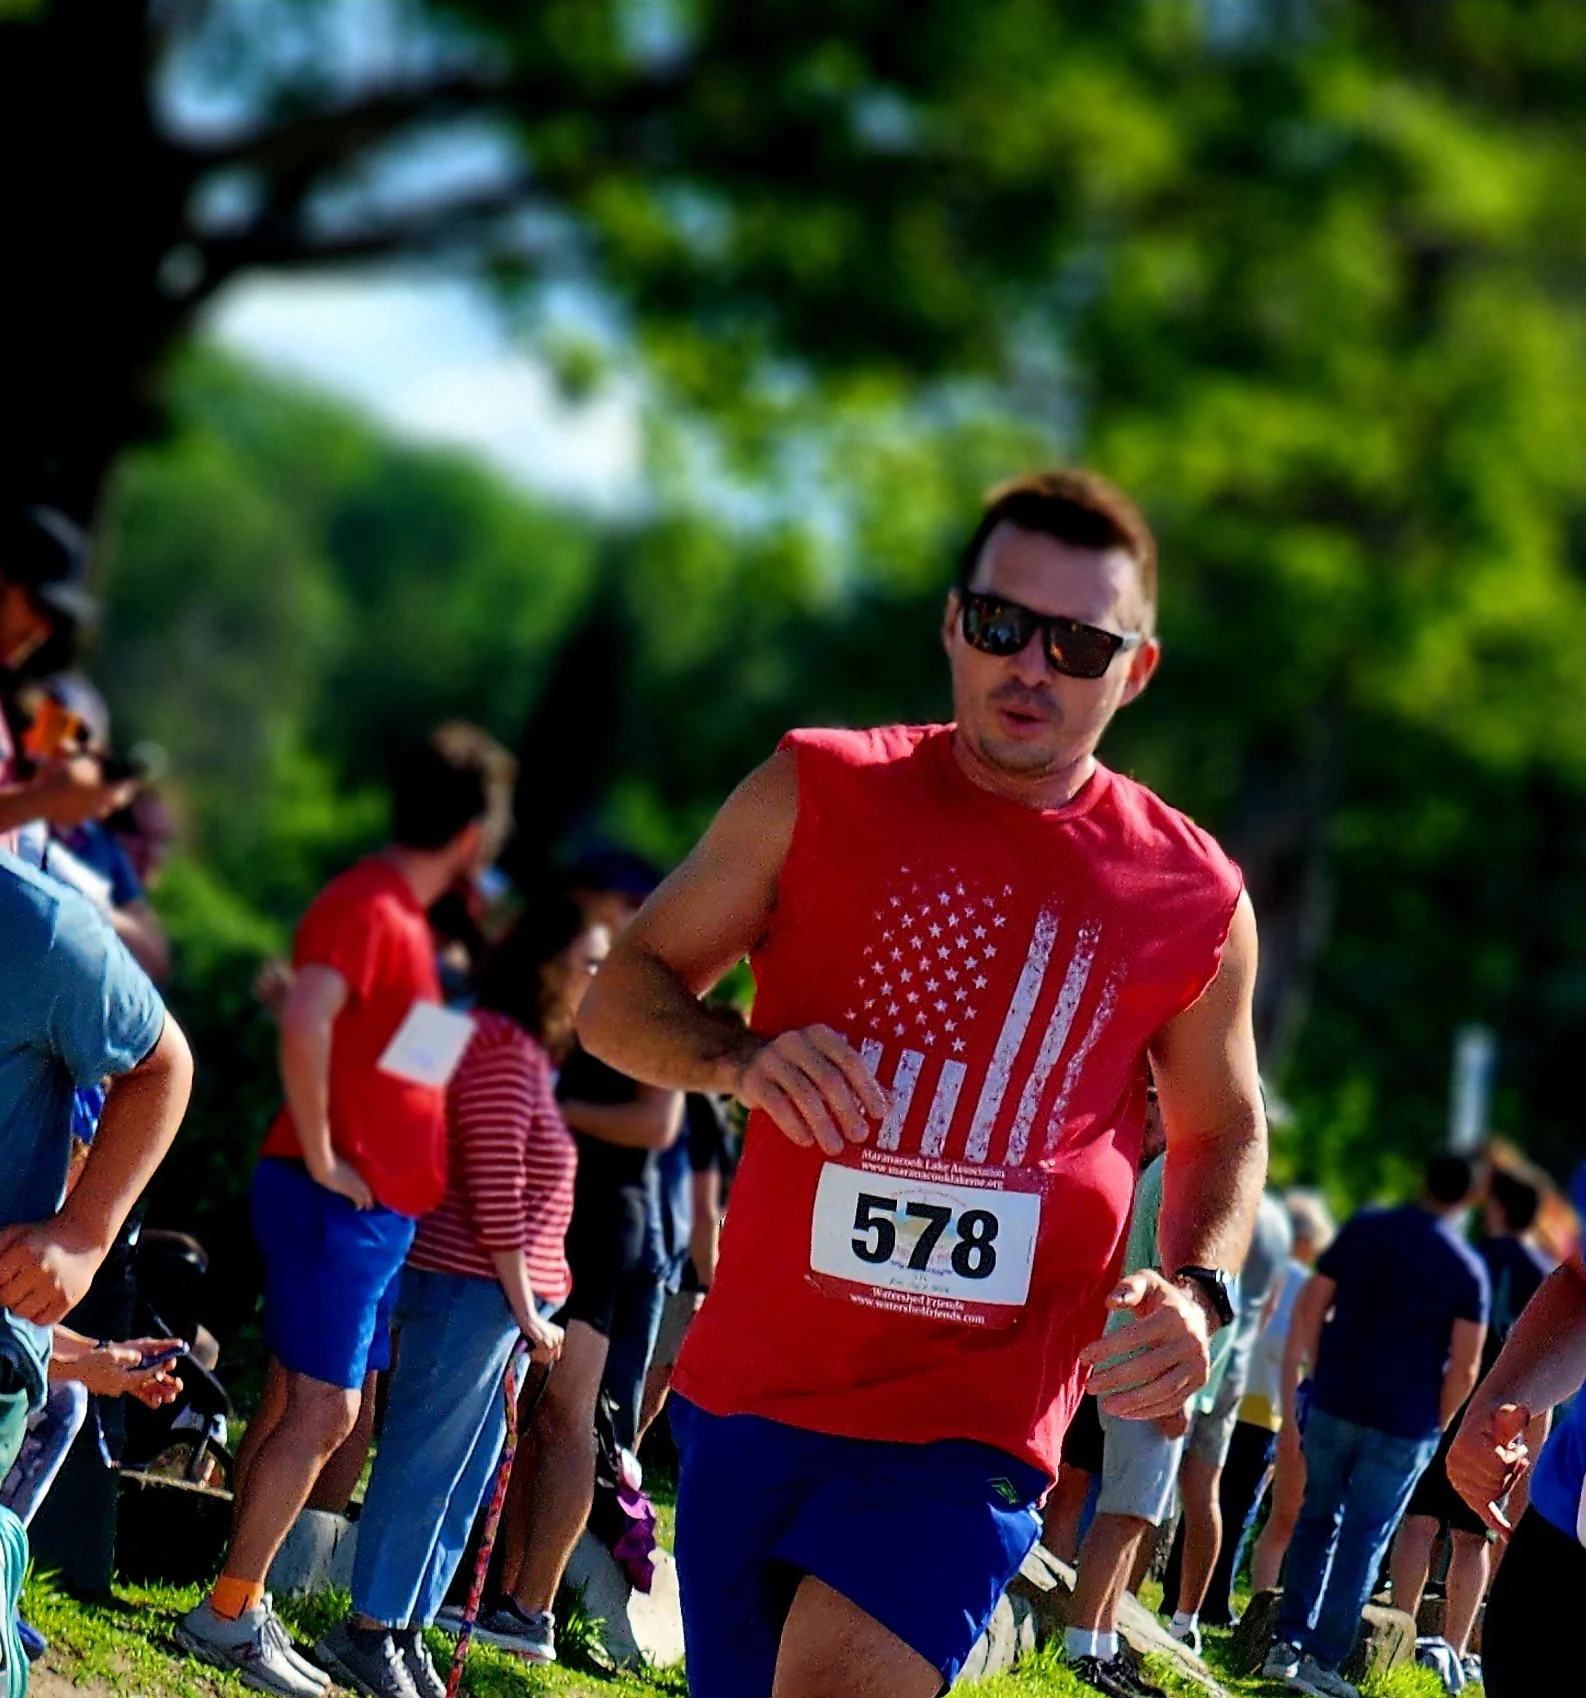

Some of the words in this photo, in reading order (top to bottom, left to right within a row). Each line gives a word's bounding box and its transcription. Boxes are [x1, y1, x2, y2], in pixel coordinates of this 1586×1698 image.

[925, 1158, 951, 1171] Lake
[951, 1163, 1005, 1178] Association
[851, 1192, 999, 1279] 578
[850, 1293, 985, 1324] www.watershedfriends.com
[870, 1287, 925, 1306] Watershed
[926, 1296, 964, 1311] Friends
